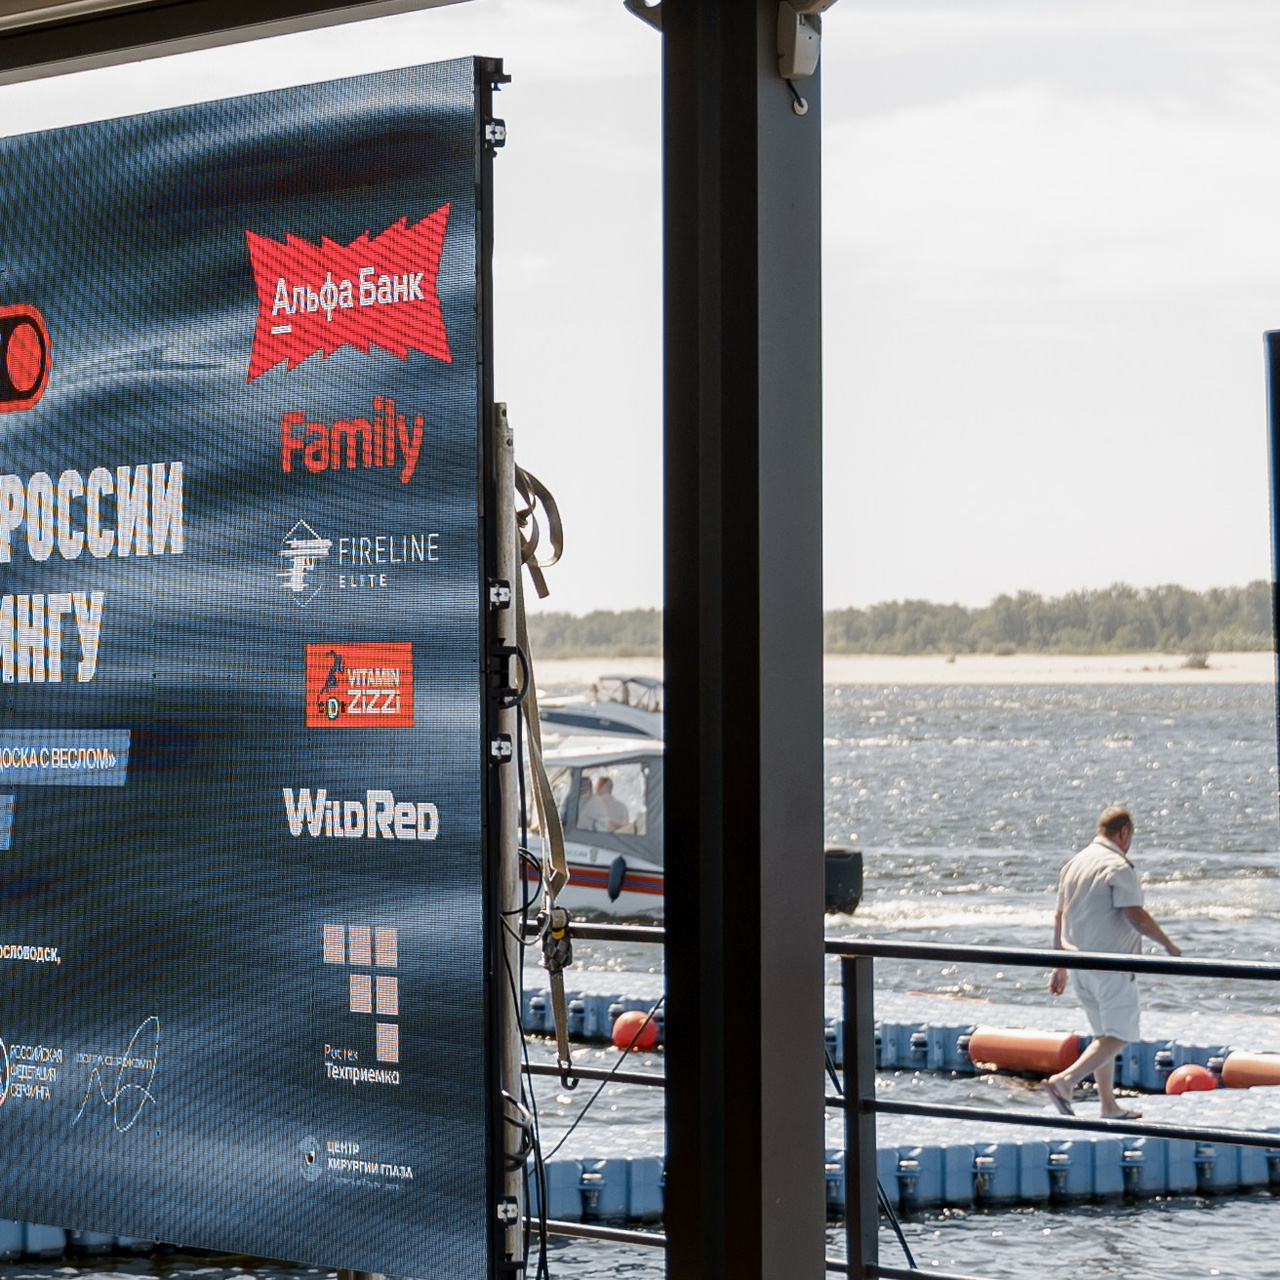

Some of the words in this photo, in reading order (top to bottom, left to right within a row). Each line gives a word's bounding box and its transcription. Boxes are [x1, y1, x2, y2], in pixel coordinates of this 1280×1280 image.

[271, 272, 354, 320] Альфа
[358, 266, 425, 306] Банк
[280, 394, 425, 484] Family
[339, 533, 440, 566] FIRELINE
[339, 574, 388, 589] ELITE
[347, 667, 401, 687] VITAMIN
[39, 748, 50, 768] С
[51, 748, 117, 770] ВЕСЛОМ»
[324, 1062, 400, 1086] Техприемка
[327, 1141, 360, 1155] ЦЕНТР
[327, 1157, 380, 1174] ХИРУРГИИ
